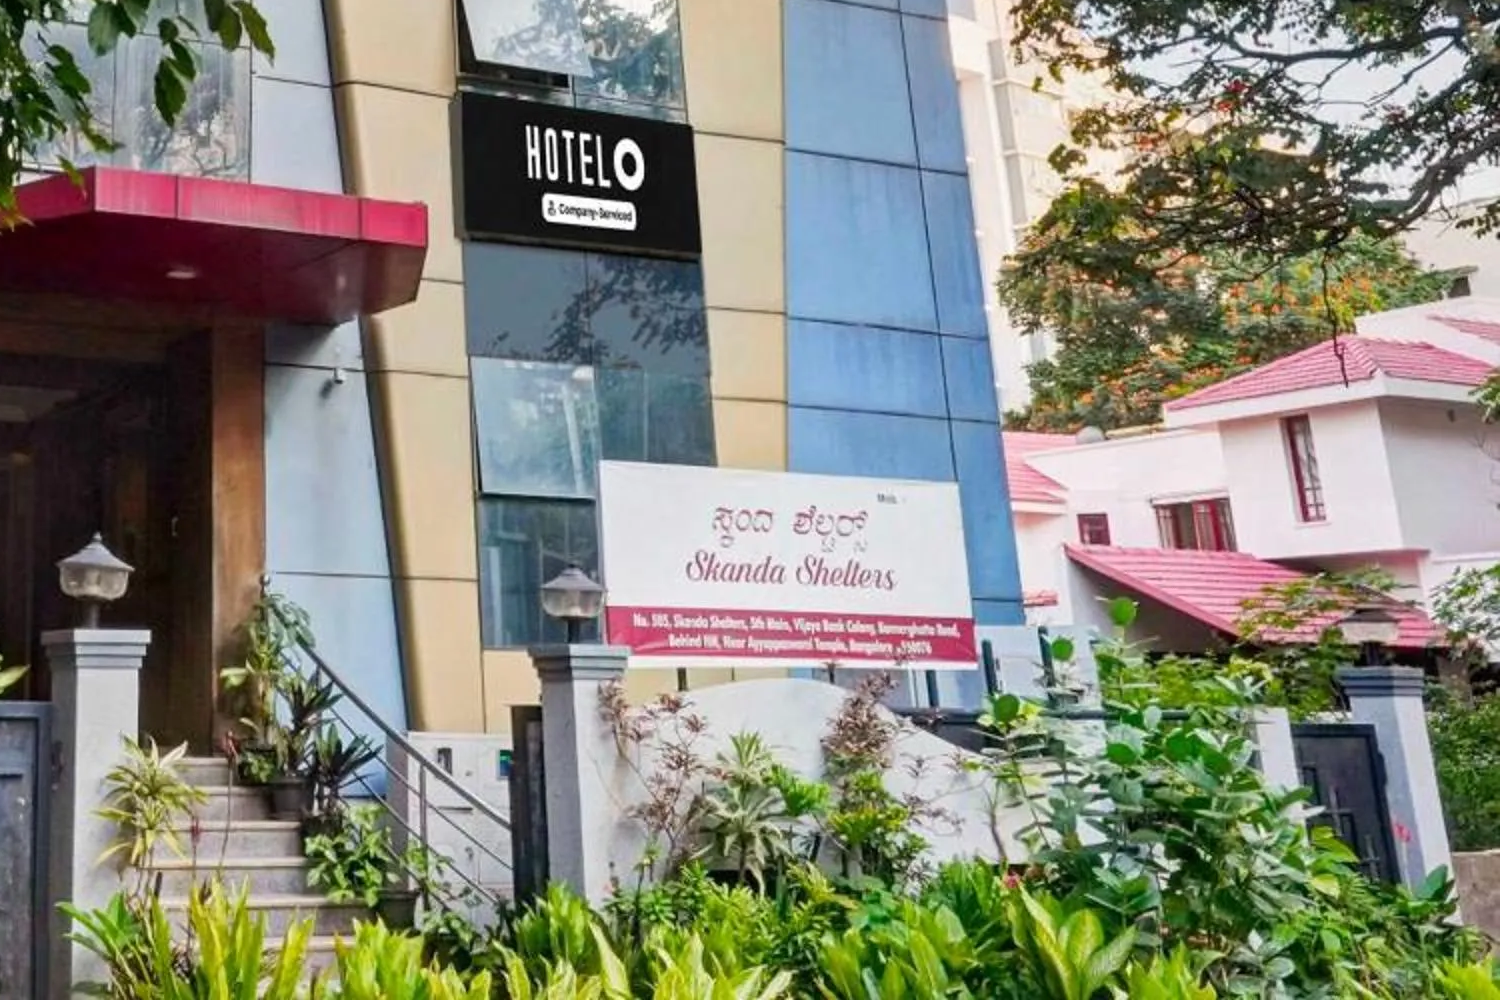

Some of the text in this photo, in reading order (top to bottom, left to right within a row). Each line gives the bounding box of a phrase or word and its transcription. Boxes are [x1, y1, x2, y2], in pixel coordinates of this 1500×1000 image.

[685, 548, 896, 591] Skanda Shelters
[673, 614, 708, 629] Skanda
[792, 617, 821, 636] Vijaya
[668, 633, 702, 648] Behind
